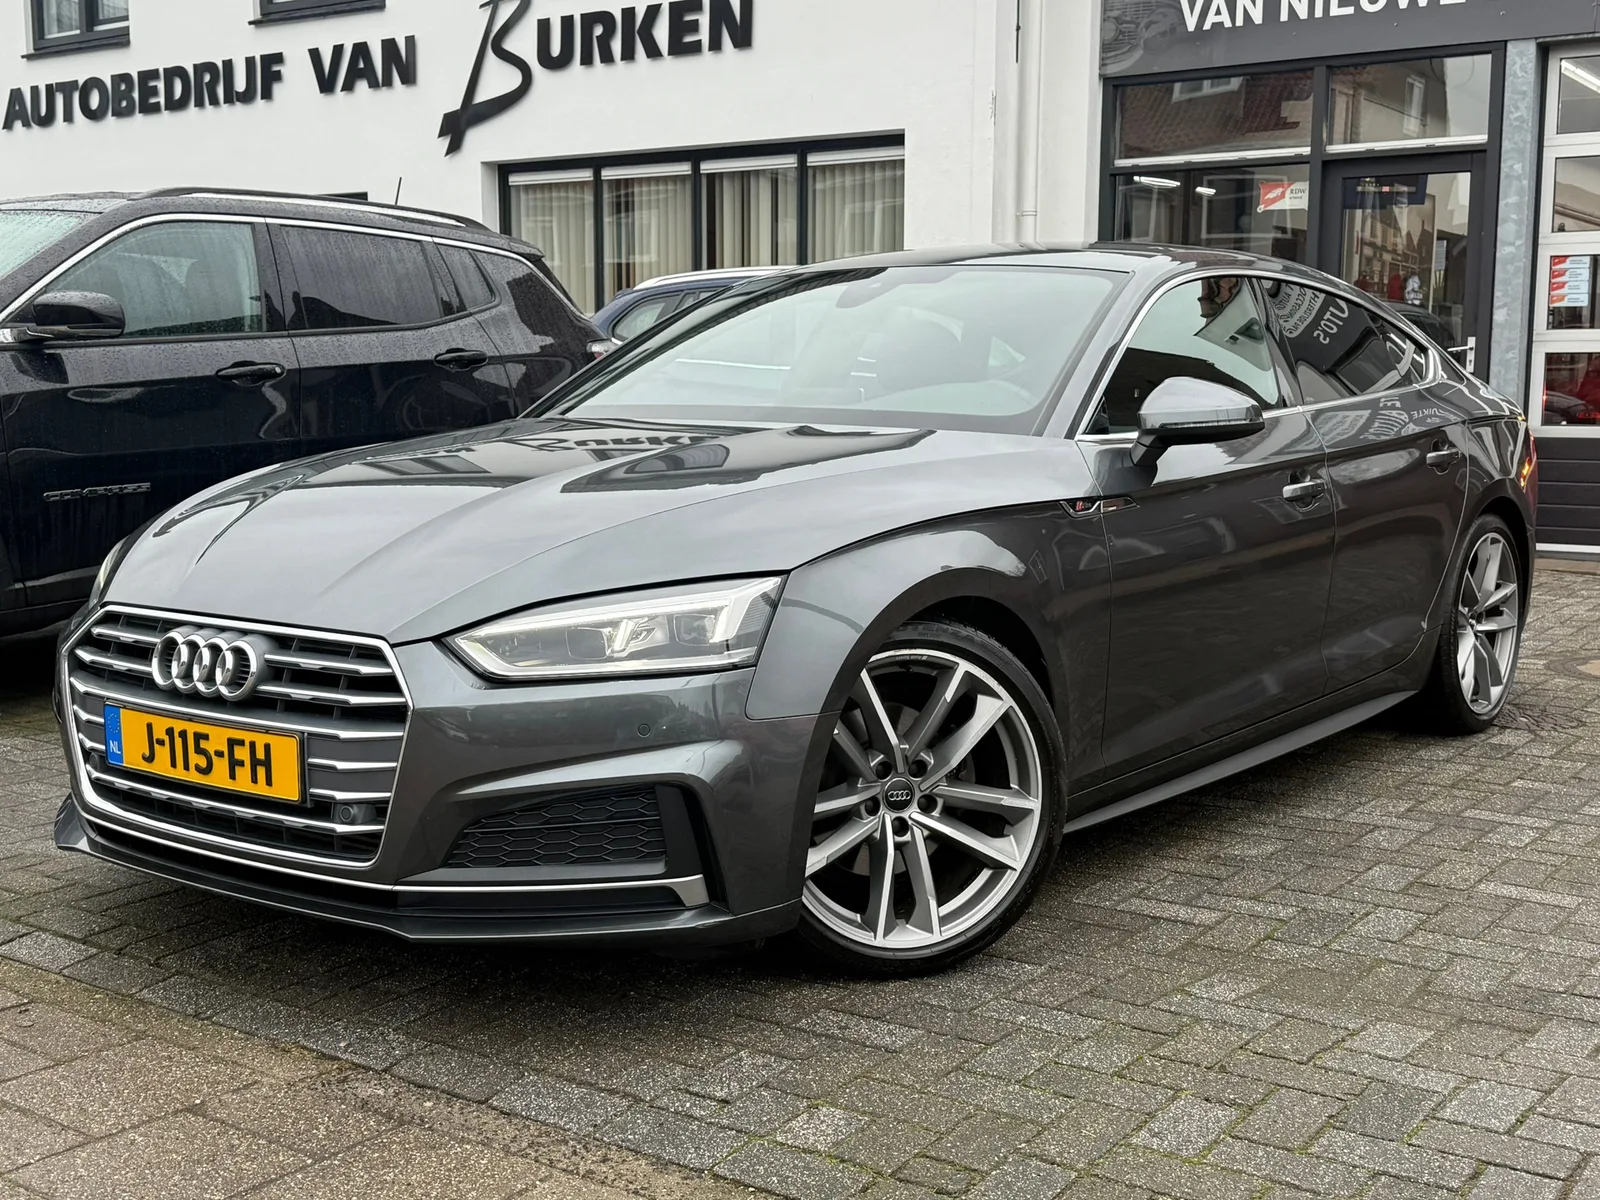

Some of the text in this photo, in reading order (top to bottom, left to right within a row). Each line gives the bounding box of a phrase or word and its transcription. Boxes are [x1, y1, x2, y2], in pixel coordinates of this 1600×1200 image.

[1180, 0, 1263, 32] VAN
[2, 0, 753, 156] AUTOBEDRIJF VAN BURKEN
[109, 740, 121, 755] NL
[141, 721, 273, 787] J-115-FH
